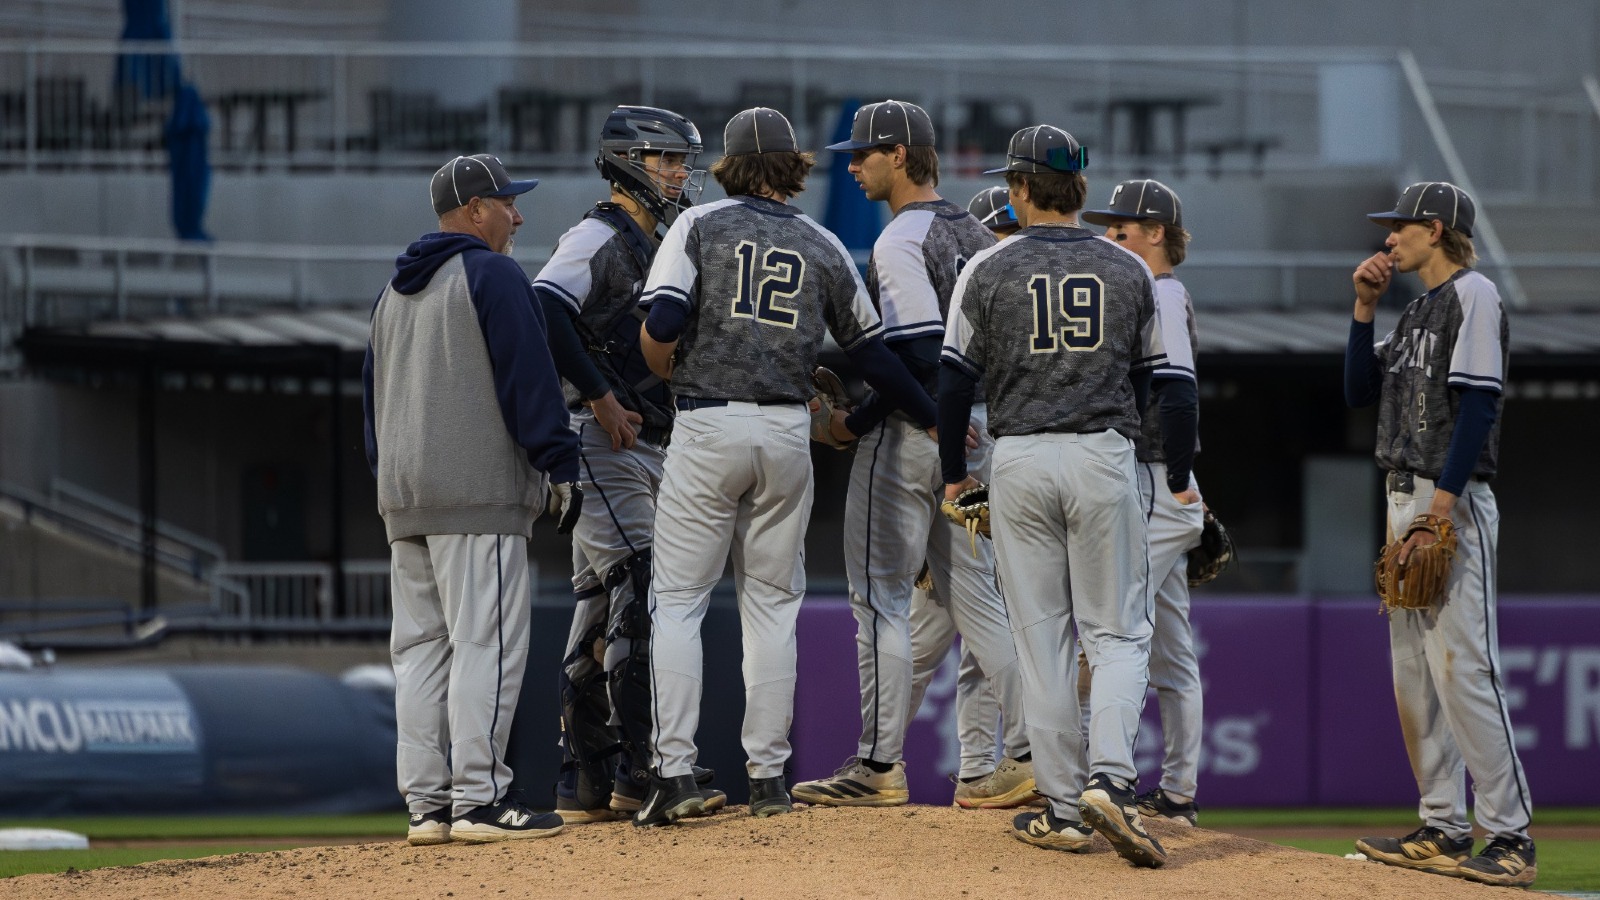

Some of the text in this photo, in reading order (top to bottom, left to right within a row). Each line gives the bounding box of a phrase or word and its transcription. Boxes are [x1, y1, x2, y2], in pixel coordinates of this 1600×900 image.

[731, 240, 806, 329] 12
[1027, 273, 1105, 354] 19
[0, 698, 83, 753] MCU
[497, 808, 532, 827] N
